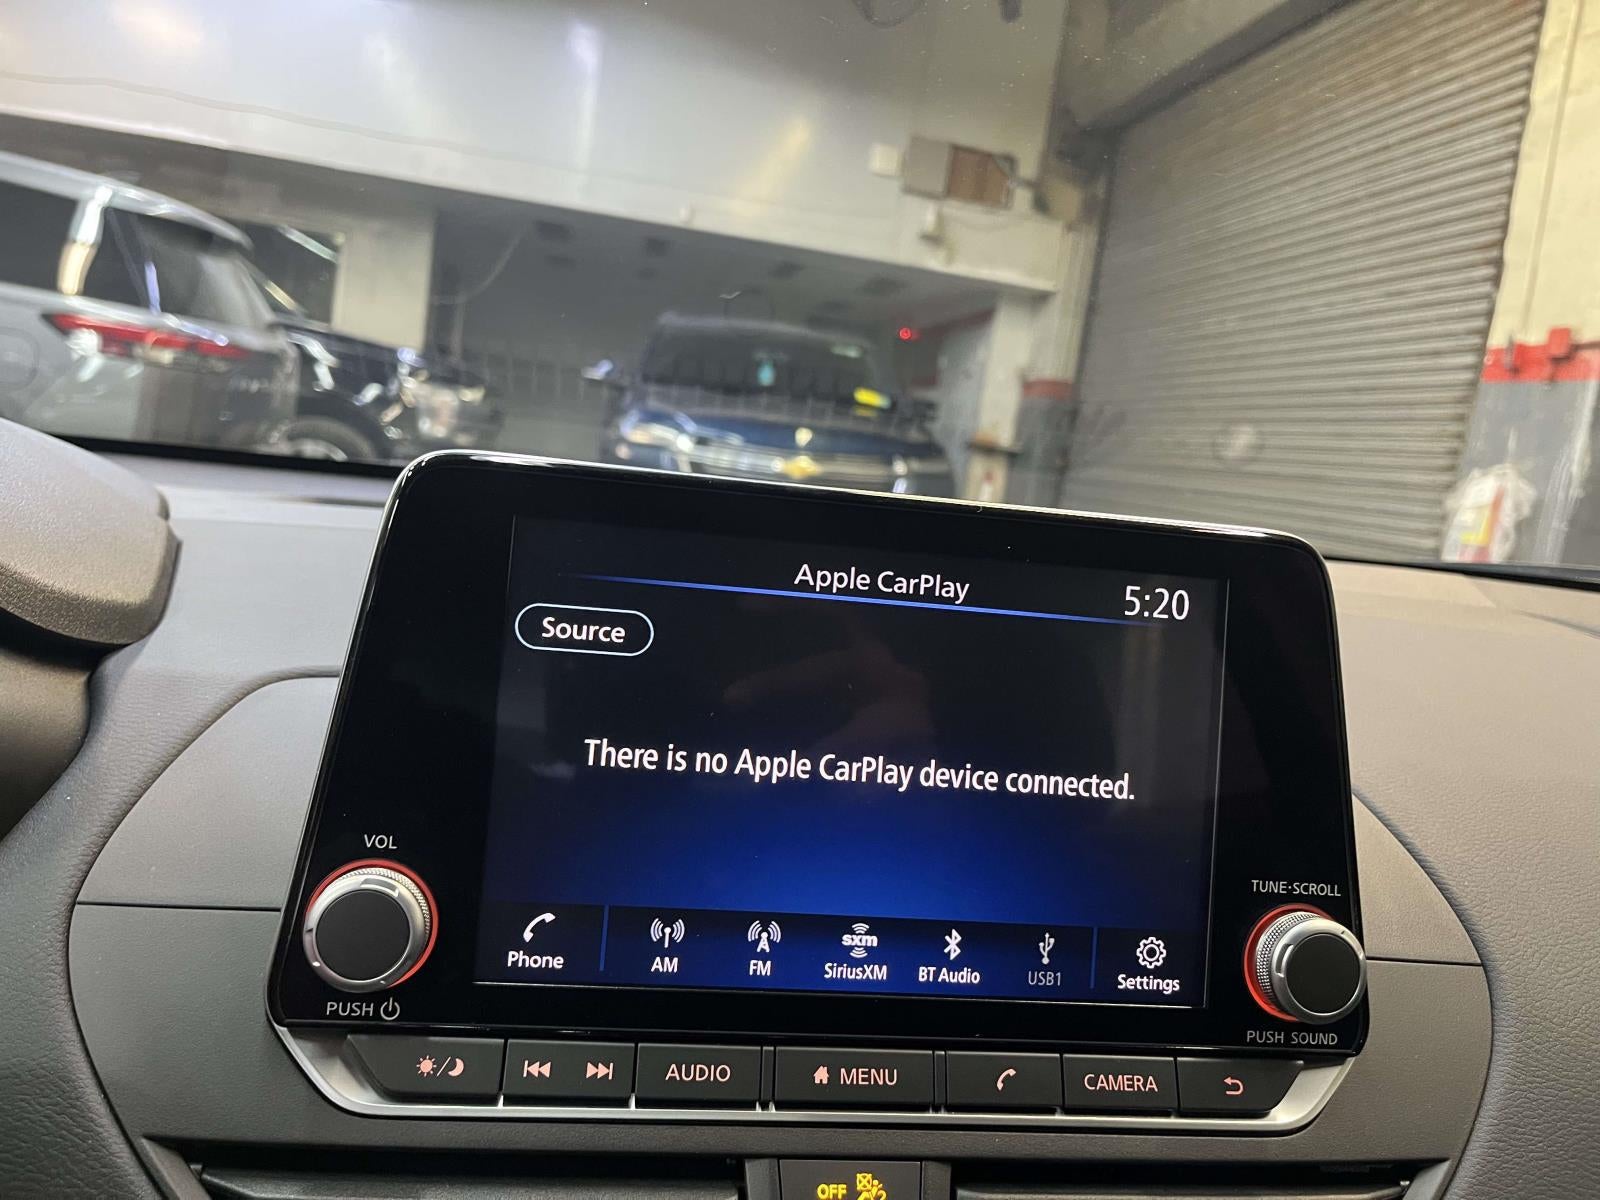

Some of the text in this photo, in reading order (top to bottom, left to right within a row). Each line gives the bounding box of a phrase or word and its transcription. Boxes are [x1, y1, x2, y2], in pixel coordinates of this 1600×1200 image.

[793, 564, 970, 605] Apple CarPlay
[1124, 585, 1190, 621] 5:20
[541, 614, 627, 644] Source
[585, 738, 1135, 801] There is no Apple CarPlay device connected.
[364, 834, 397, 850] VOL
[842, 932, 878, 948] sxm
[507, 950, 564, 971] Phone
[651, 957, 679, 974] AM
[749, 960, 772, 976] FM
[824, 962, 888, 981] SiriusXM
[918, 966, 981, 984] BT Audio
[1028, 971, 1061, 986] USB1
[1117, 973, 1180, 994] Settings
[326, 1001, 374, 1017] PUSH
[1246, 1030, 1338, 1046] PUSH SOUND
[665, 1063, 731, 1082] AUDIO
[840, 1067, 898, 1086] MENU
[1084, 1073, 1159, 1093] CAMERA
[816, 1183, 847, 1200] OFF
